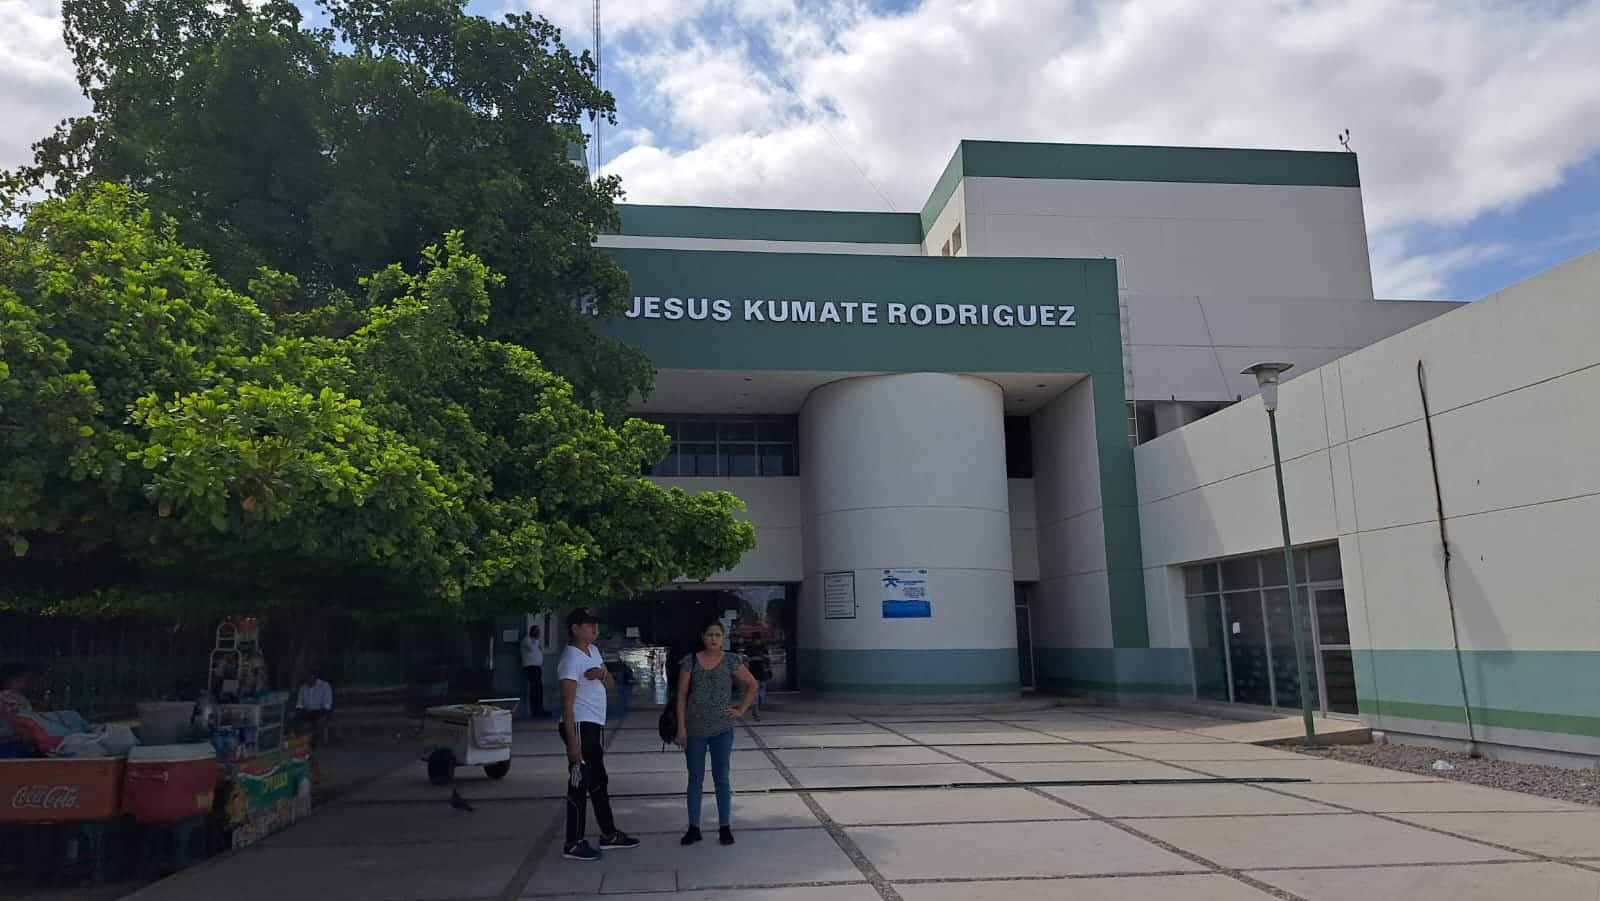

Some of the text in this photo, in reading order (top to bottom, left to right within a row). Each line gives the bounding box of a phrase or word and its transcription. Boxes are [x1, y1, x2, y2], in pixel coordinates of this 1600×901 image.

[626, 296, 731, 321] JESUS
[743, 300, 878, 324] KUMATE
[887, 302, 1077, 327] RODRIGUEZ
